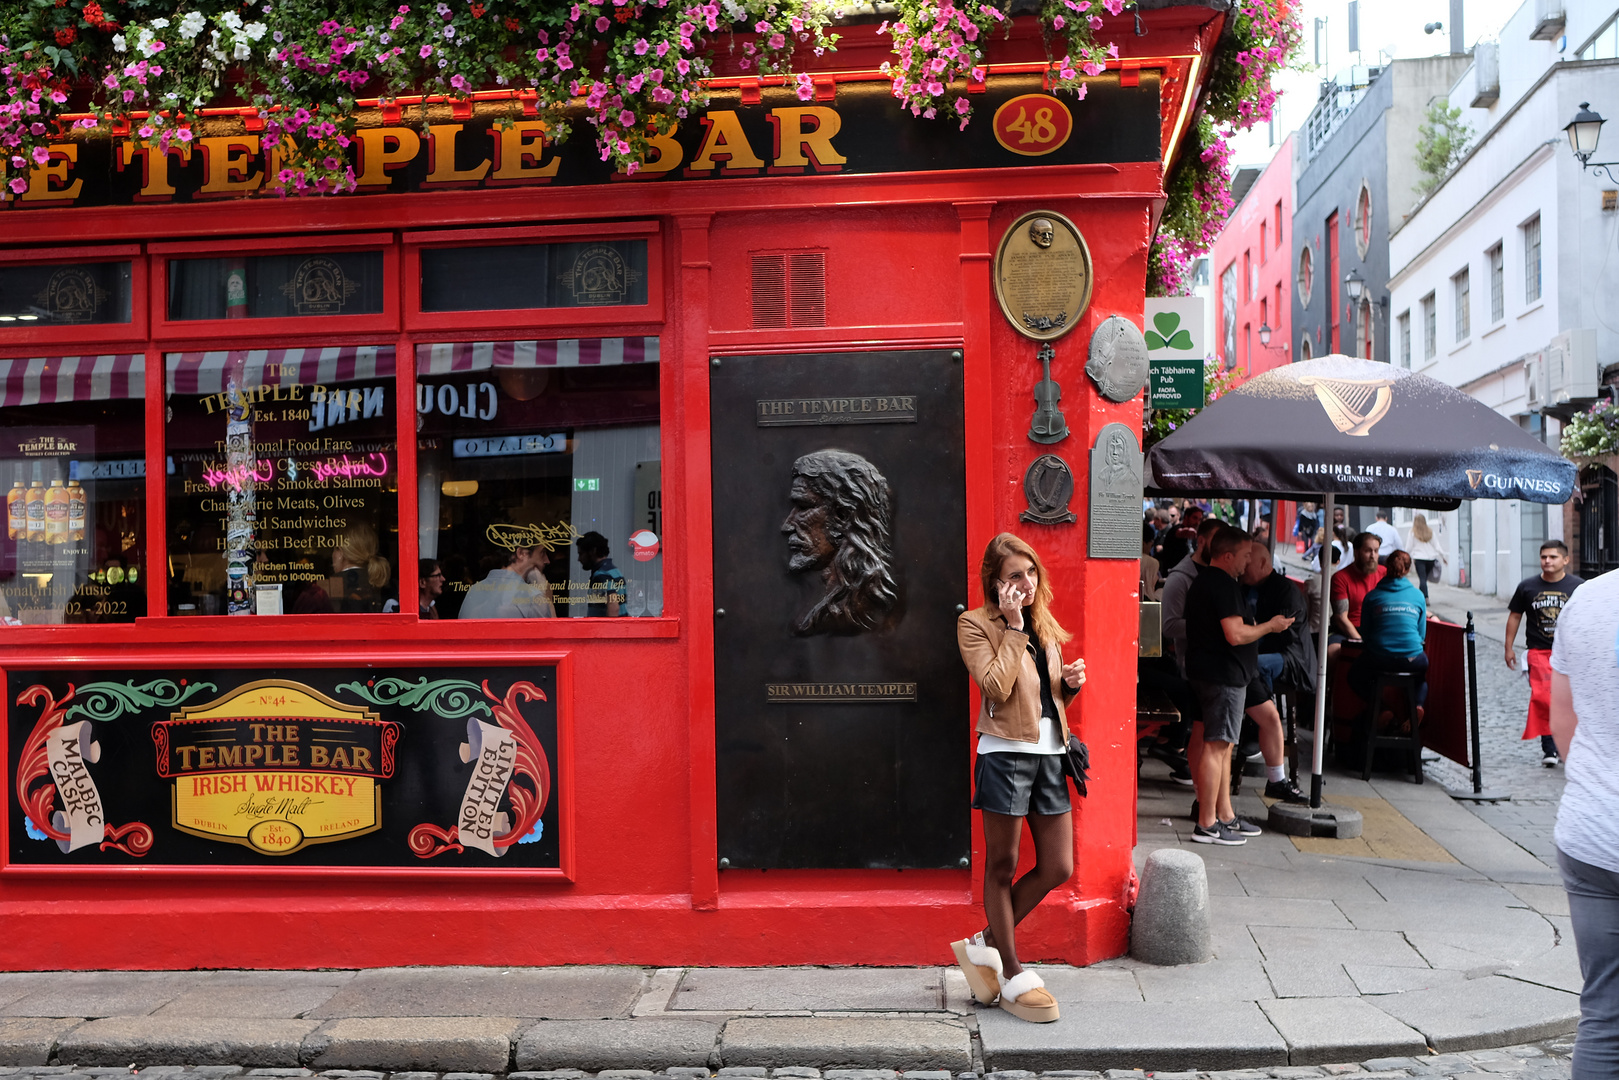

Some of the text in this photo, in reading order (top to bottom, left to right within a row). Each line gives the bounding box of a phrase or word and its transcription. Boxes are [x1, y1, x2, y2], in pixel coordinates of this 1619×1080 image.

[1006, 106, 1057, 144] 48
[612, 106, 847, 177] BAR
[267, 364, 296, 377] The
[200, 383, 304, 415] TEMPLE
[310, 384, 363, 412] BAR
[758, 398, 914, 415] THE TEMPLE BAR
[255, 409, 310, 422] Est. 1840
[18, 442, 76, 452] TEMPLE BAR
[214, 438, 352, 453] Trional Food Fare
[202, 460, 230, 472] Mea
[277, 457, 322, 471] Ceese
[327, 457, 365, 470] Board
[1298, 463, 1414, 478] RAISING THE BAR
[184, 476, 381, 493] Fresh Oers, Smoked Salmon
[1337, 474, 1374, 484] GUINNESS
[1484, 474, 1560, 495] GUINNESS
[201, 495, 365, 512] Charrie Meats, Olives
[272, 515, 346, 529] Sandwiches
[283, 535, 314, 548] Beef
[317, 535, 350, 548] Rolls
[252, 562, 286, 571] Kitchen
[290, 573, 325, 583] 10:00pm
[550, 580, 566, 590] and
[568, 580, 590, 590] loved
[592, 579, 608, 590] and
[72, 583, 111, 596] Music
[553, 595, 586, 605] Finnegans
[95, 601, 127, 615] 2022
[768, 684, 914, 696] SIR WILLIAM TEMPLE
[249, 723, 300, 742] THE
[176, 744, 374, 772] TEMPLE BAR
[53, 760, 82, 817] CASK
[62, 738, 101, 827] MALBEC
[193, 774, 358, 797] IRISH WHISKEY
[461, 747, 498, 834] EDITION
[477, 741, 513, 840] LIMITED
[234, 794, 318, 820] Single Malt
[194, 818, 360, 832] DUBLIN IRELAND
[262, 834, 291, 847] 1840
